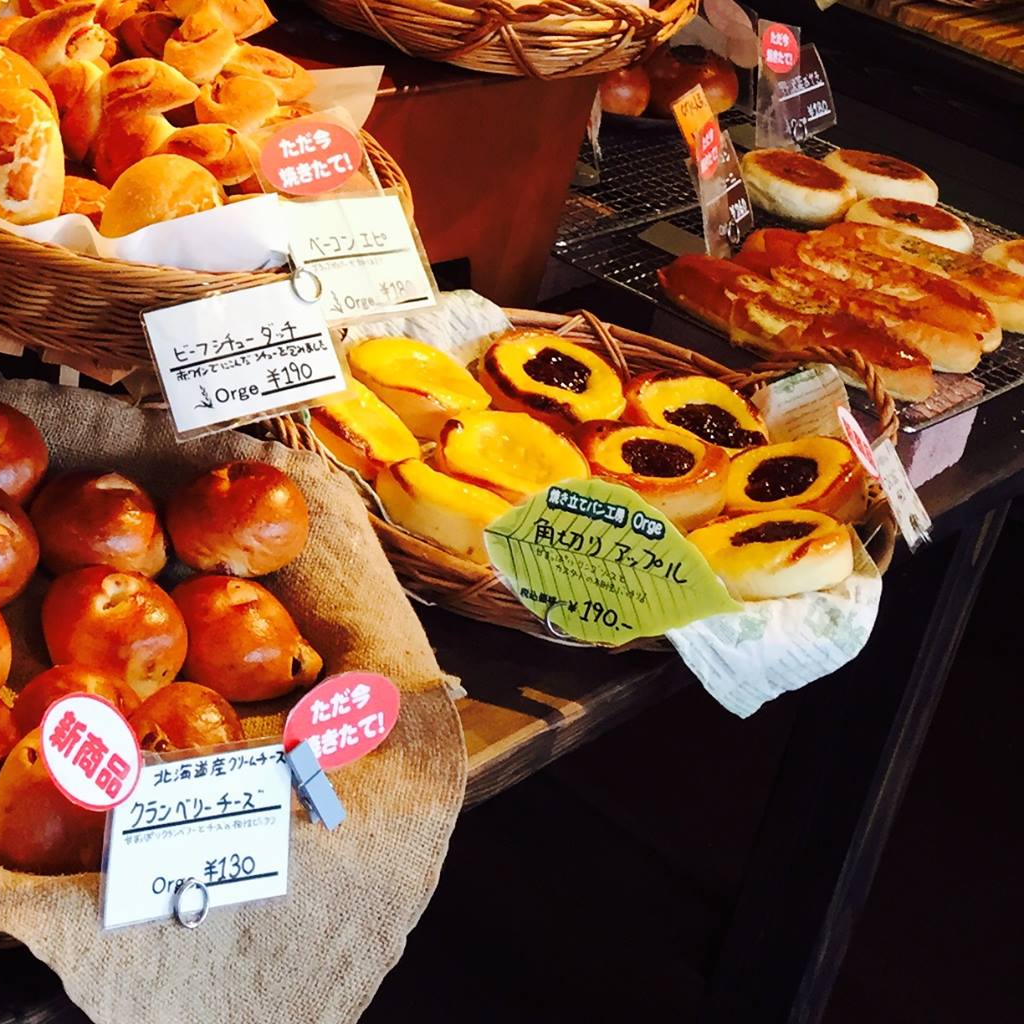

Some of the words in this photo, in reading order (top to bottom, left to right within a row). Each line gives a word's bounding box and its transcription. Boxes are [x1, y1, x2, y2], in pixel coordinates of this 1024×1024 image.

[278, 129, 332, 159] ただ今
[344, 295, 375, 311] Orge
[173, 333, 255, 364] ビーフシチュー
[215, 383, 260, 405] Orge
[266, 362, 314, 390] ¥190
[549, 488, 626, 524] 焼き立てパン工房
[632, 512, 664, 538] Orge
[533, 517, 603, 557] 角切り
[615, 542, 688, 585] アップル
[311, 683, 372, 724] ただ今
[49, 711, 131, 799] 新商品
[154, 757, 227, 787] 北海道産
[129, 796, 212, 829] クランベリー
[204, 852, 257, 883] ¥130
